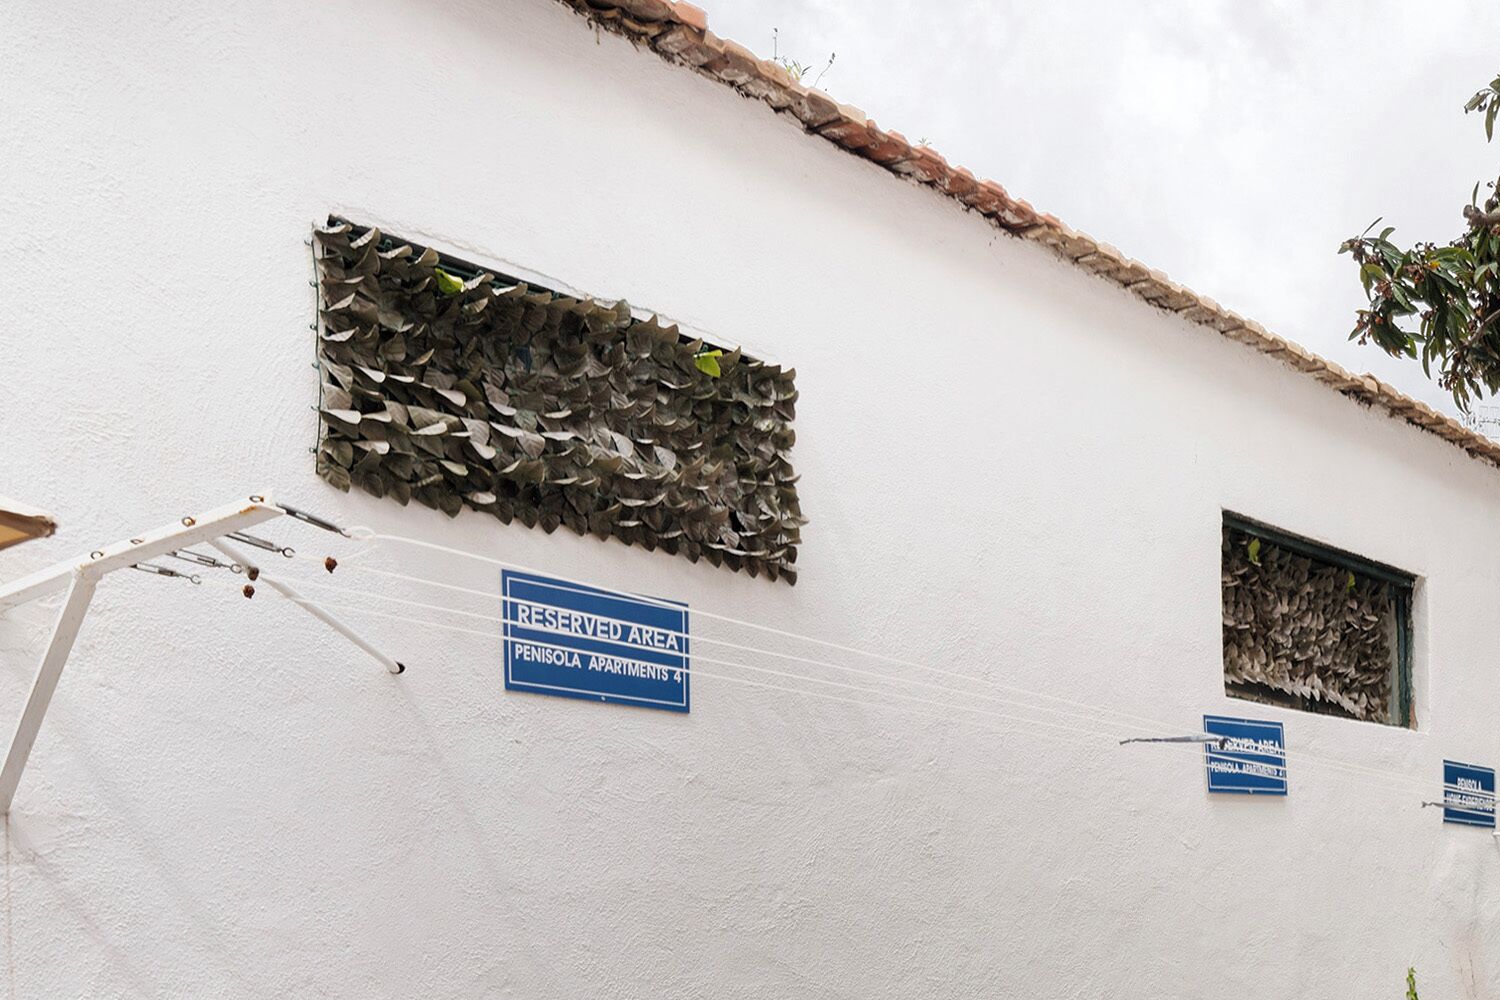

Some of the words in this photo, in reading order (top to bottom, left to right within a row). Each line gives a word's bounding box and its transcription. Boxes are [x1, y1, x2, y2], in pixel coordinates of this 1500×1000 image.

[517, 604, 622, 641] RESERVED
[627, 624, 679, 650] AREA
[514, 644, 582, 669] PENISOLA
[588, 655, 669, 681] APARTMENTS
[673, 668, 682, 684] 4
